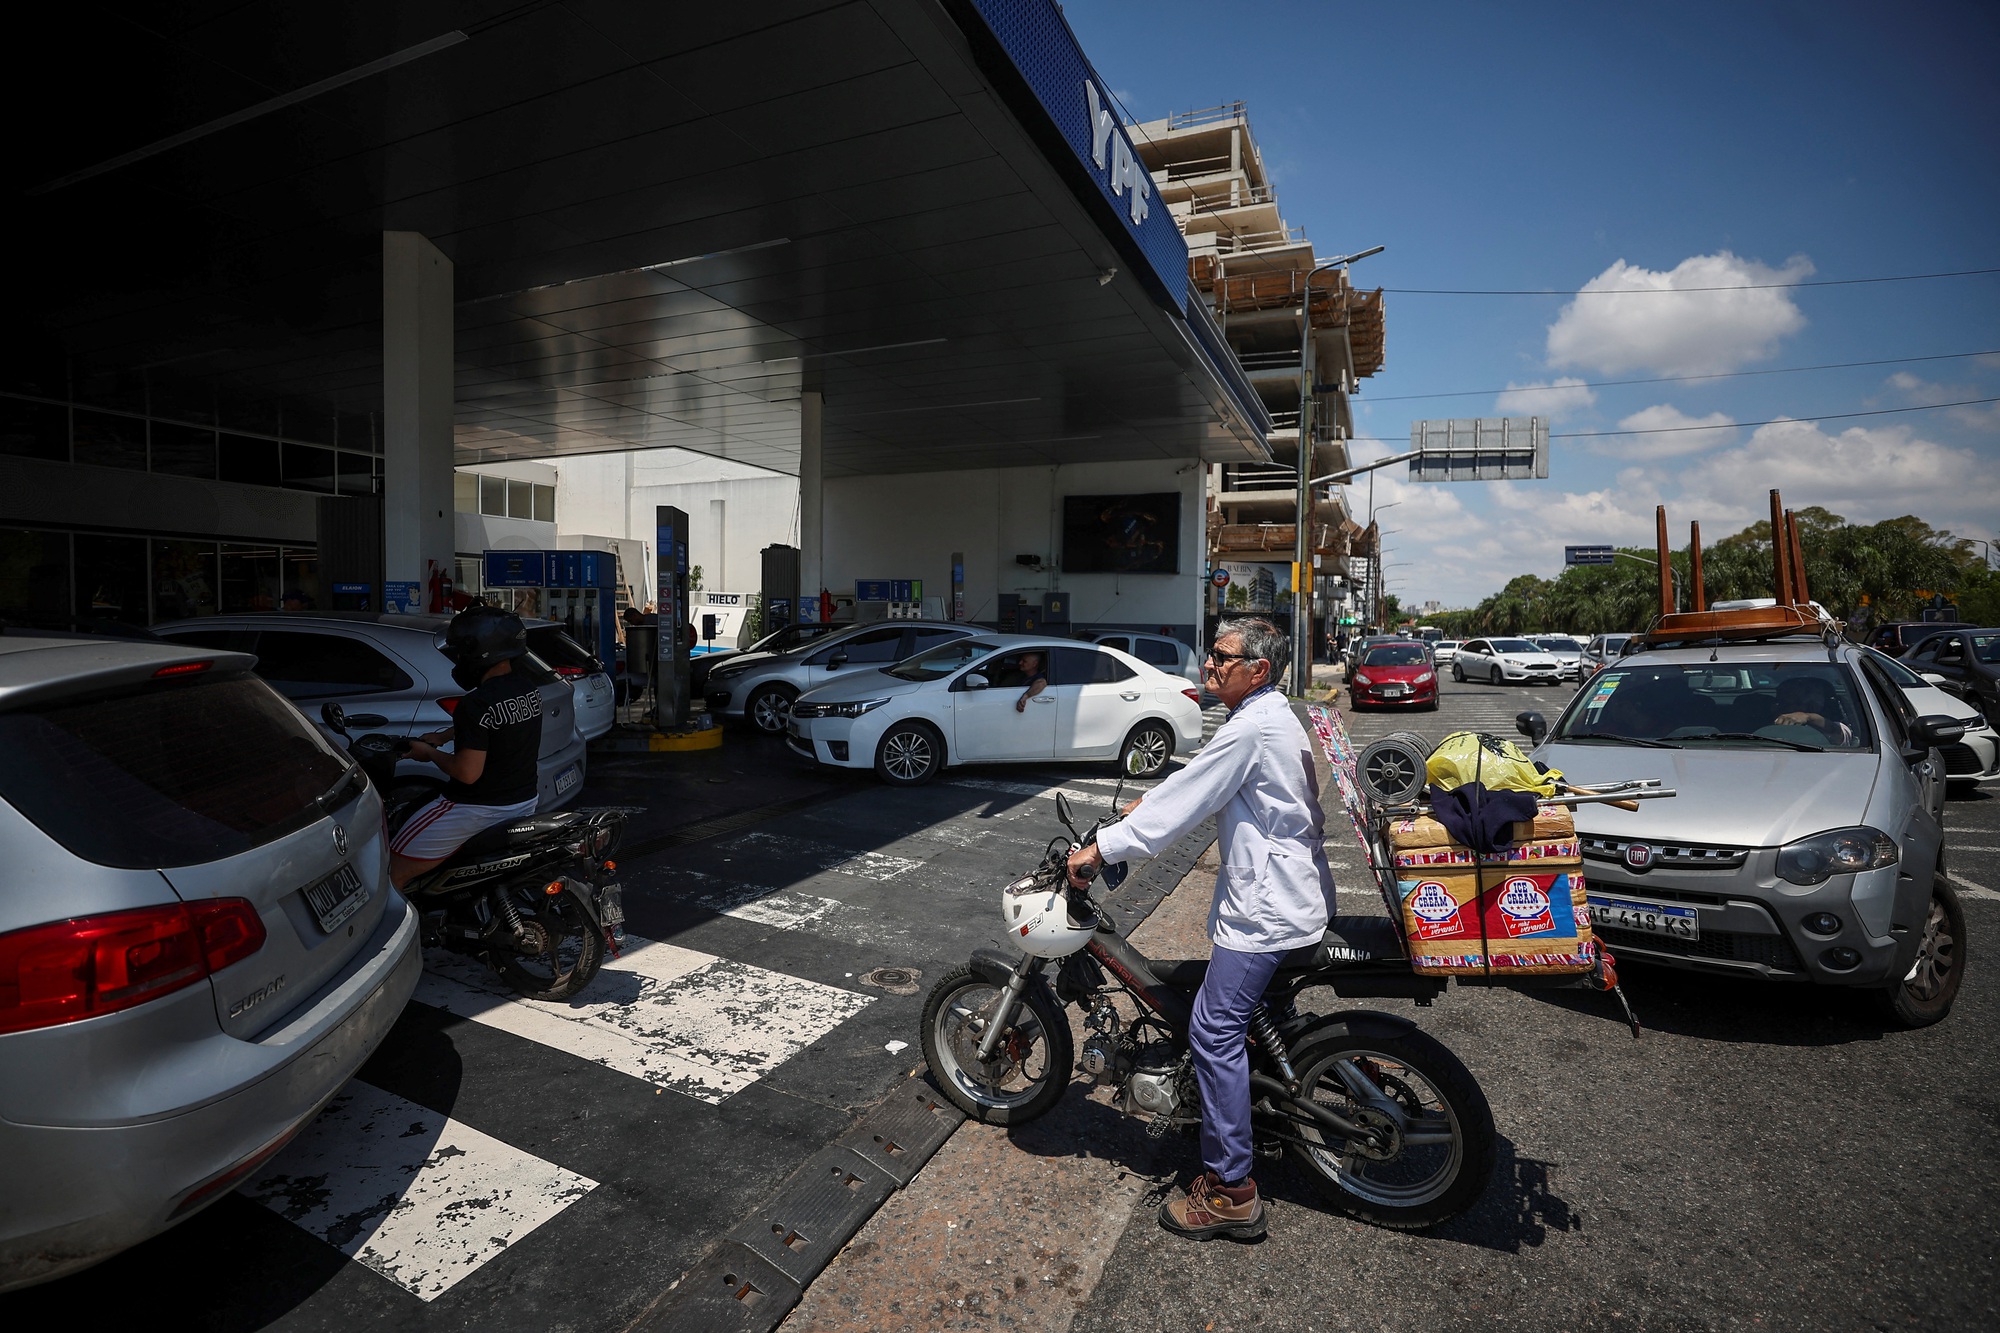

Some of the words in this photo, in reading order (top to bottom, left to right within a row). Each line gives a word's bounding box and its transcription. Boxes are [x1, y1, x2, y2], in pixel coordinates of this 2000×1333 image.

[1085, 79, 1150, 226] YPF
[708, 594, 738, 605] HIELO
[507, 825, 535, 834] YAMAHA
[1630, 850, 1647, 862] FIAT
[309, 880, 338, 916] MUV
[334, 865, 361, 897] 241
[1424, 886, 1438, 897] ICE
[1513, 882, 1528, 893] ICE
[1418, 896, 1448, 908] CREAM
[1507, 893, 1539, 905] CREAM
[1431, 921, 1459, 935] verano!
[1520, 918, 1550, 933] verano!
[1619, 910, 1657, 931] 418
[1665, 916, 1693, 937] KS
[1327, 946, 1371, 961] YAMAHA
[230, 974, 285, 1019] SURAN
[1089, 1054, 1097, 1070] CDI
